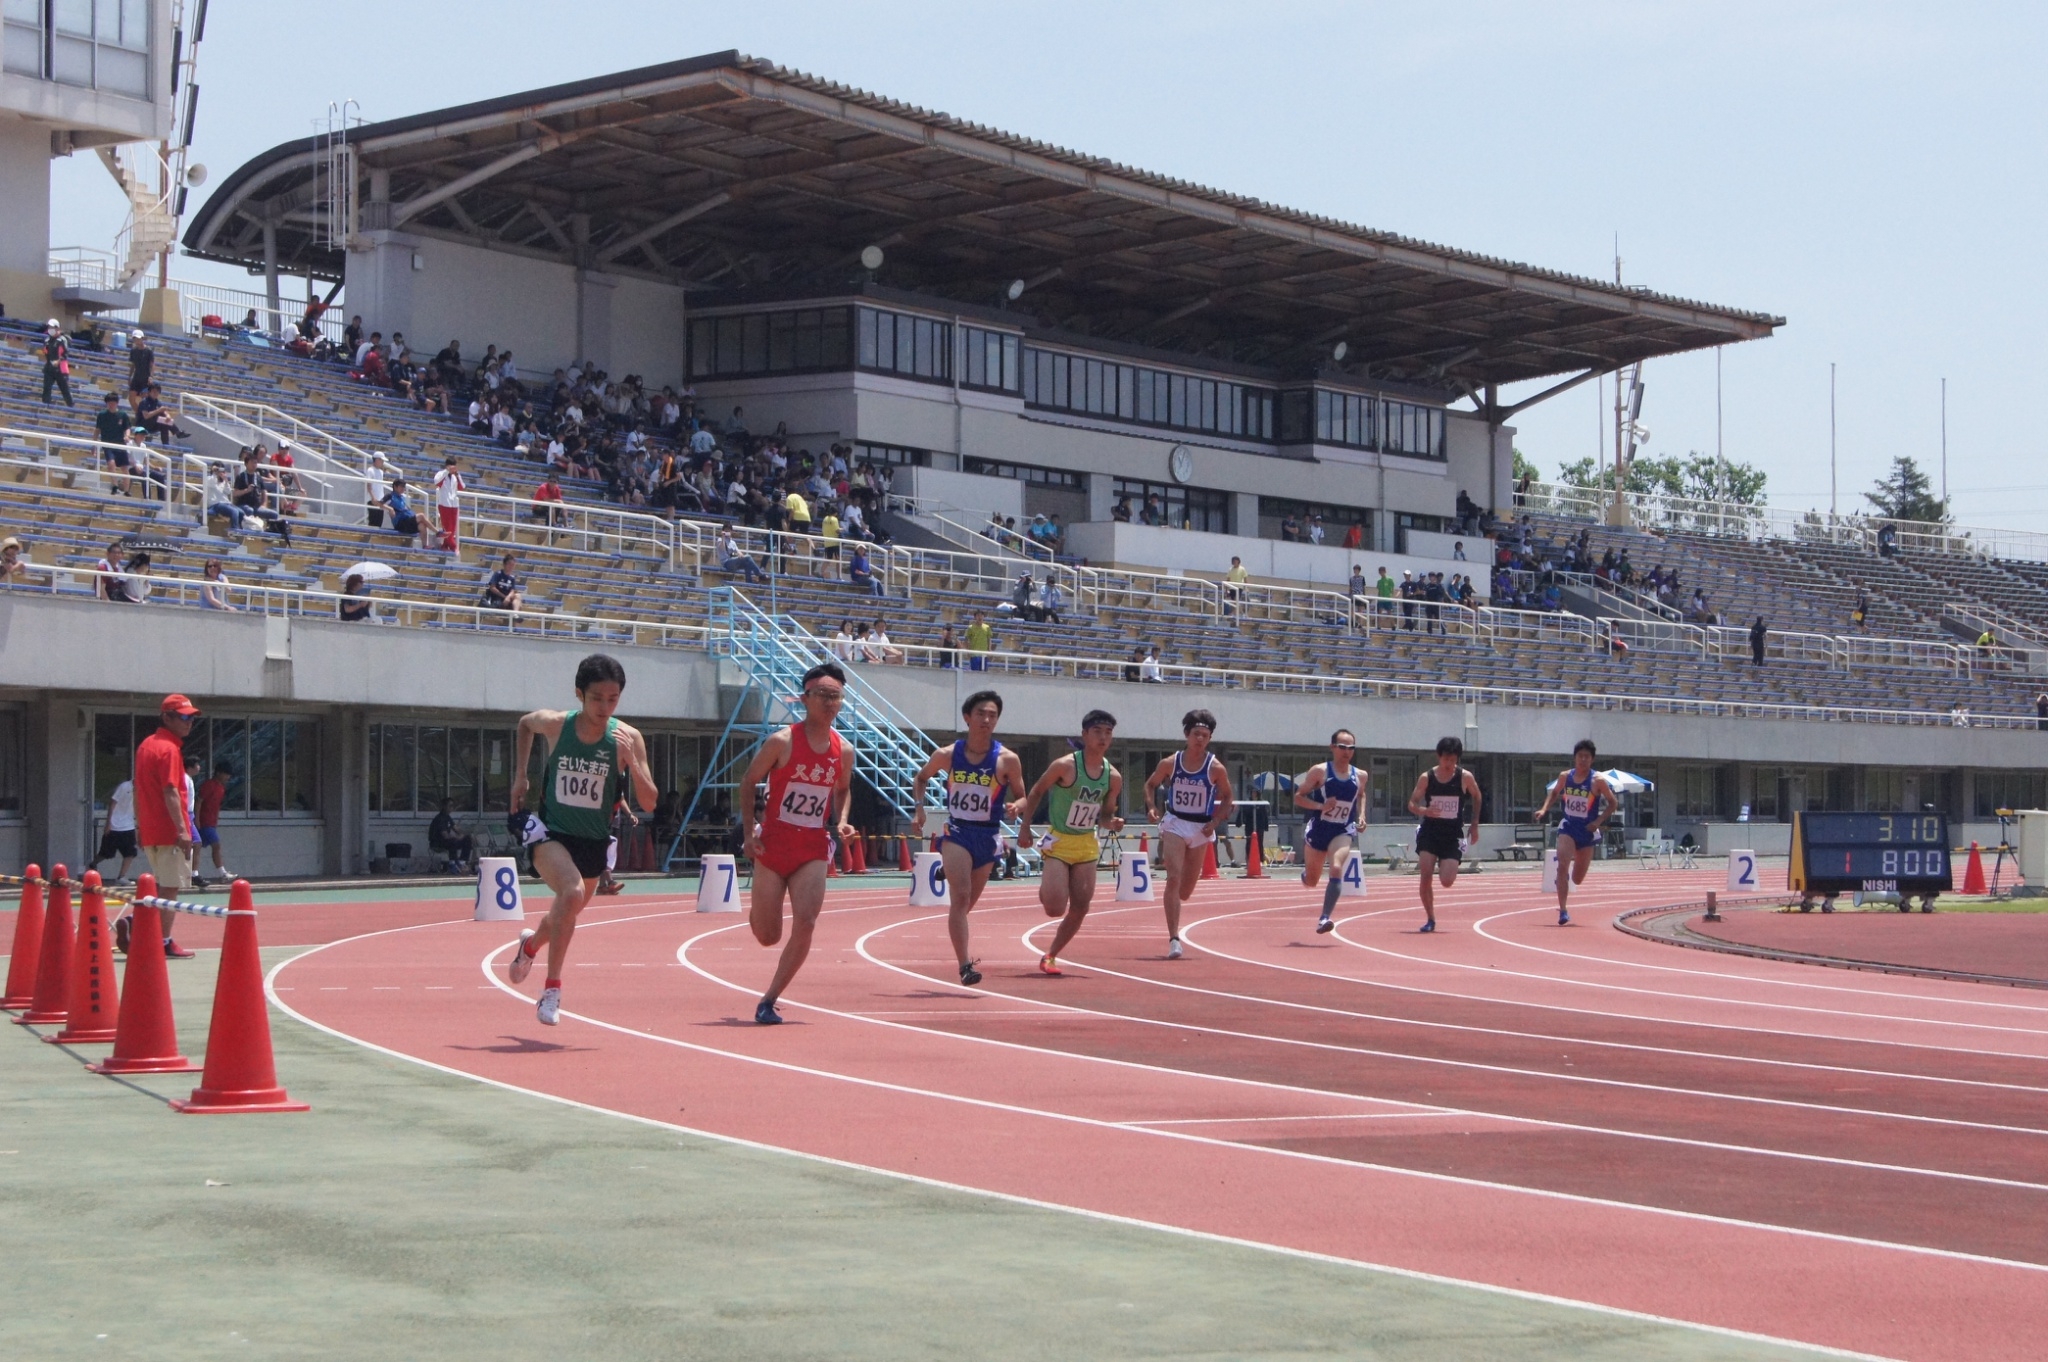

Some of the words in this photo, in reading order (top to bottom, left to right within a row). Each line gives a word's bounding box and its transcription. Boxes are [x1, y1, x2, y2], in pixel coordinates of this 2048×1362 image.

[558, 755, 610, 777] さいたま市
[954, 770, 991, 786] 西武台
[561, 775, 599, 802] 1086
[950, 791, 989, 813] 4694
[1079, 787, 1101, 801] M
[1175, 790, 1203, 807] 5371
[782, 791, 827, 818] 4236
[1132, 859, 1148, 894] 5
[1343, 858, 1361, 888] 4
[1738, 856, 1754, 884] 2
[1845, 851, 1851, 874] 1
[1882, 850, 1942, 876] 800
[495, 867, 517, 910] 8
[718, 864, 733, 903] 7
[929, 860, 946, 897] 6
[1862, 879, 1897, 891] NISHI
